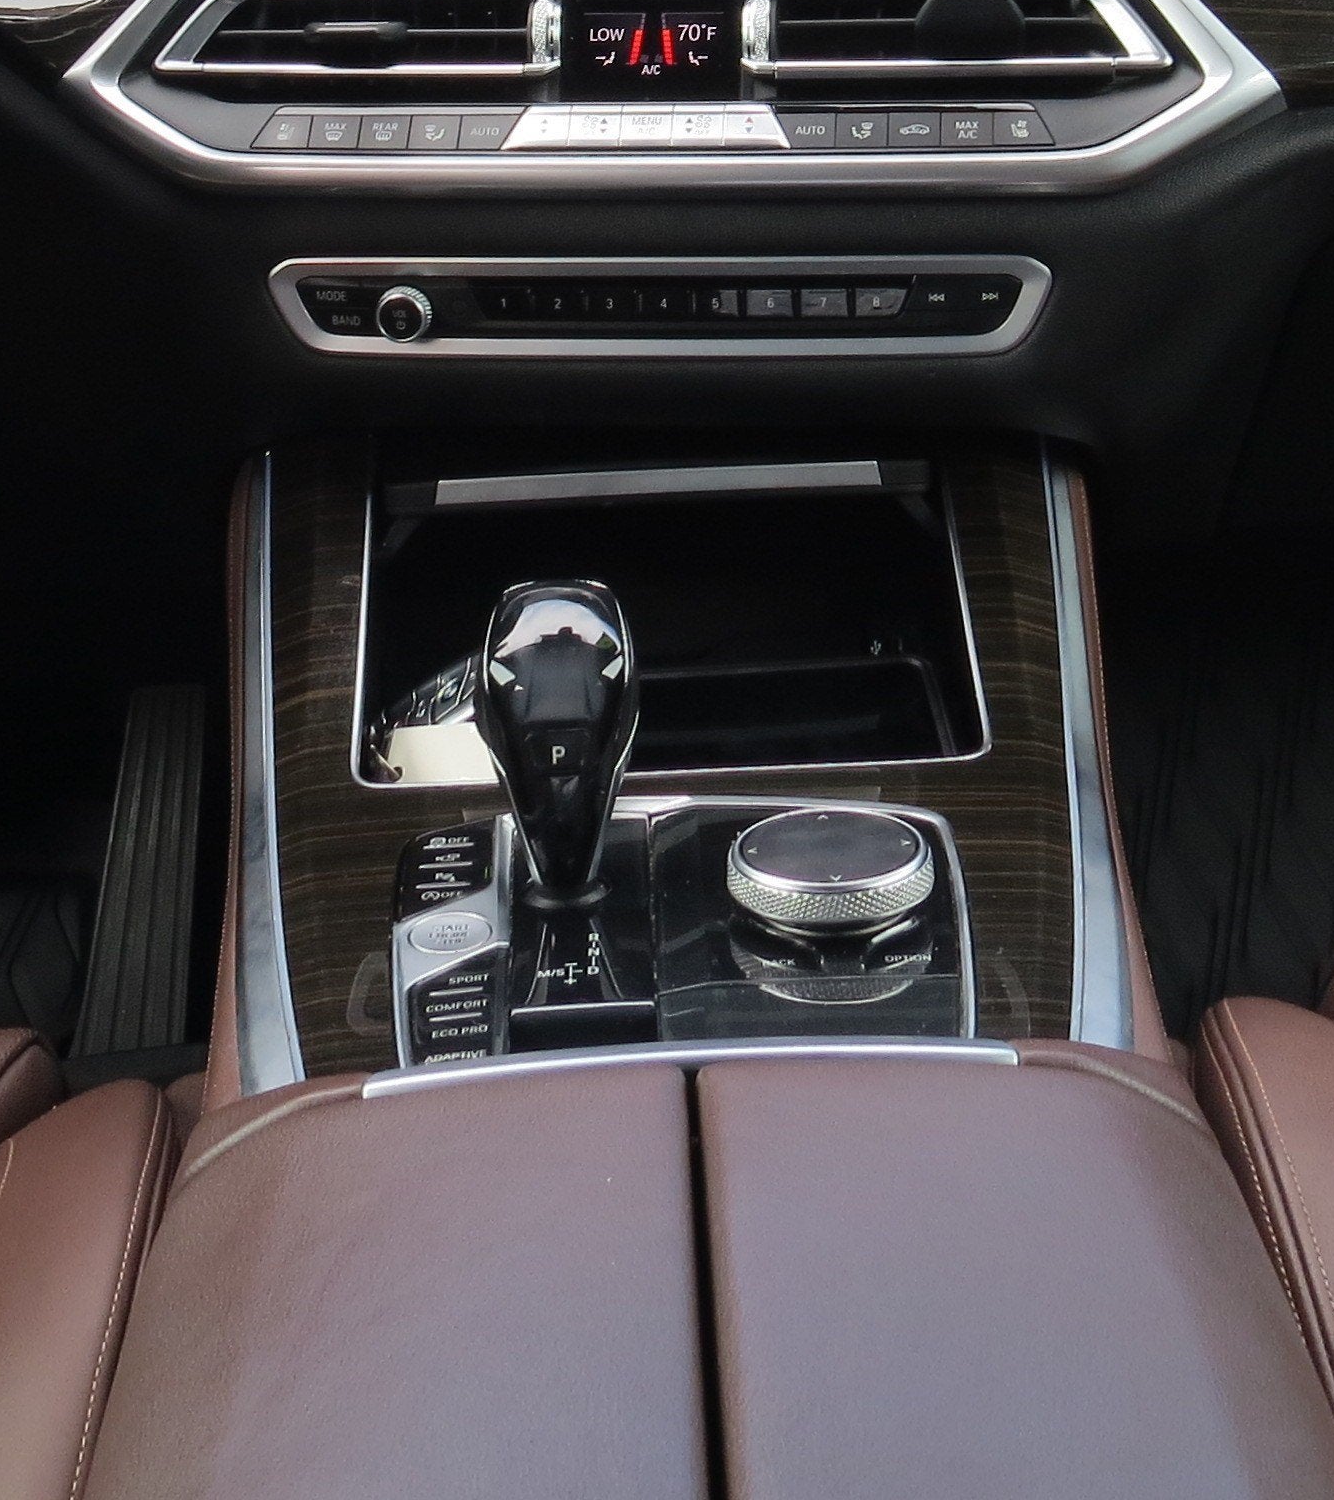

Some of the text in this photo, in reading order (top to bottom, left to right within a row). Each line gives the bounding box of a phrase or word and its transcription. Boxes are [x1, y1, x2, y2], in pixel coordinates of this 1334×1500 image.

[589, 27, 625, 43] LOW
[677, 23, 718, 42] 70°F
[640, 64, 662, 76] A/C
[631, 115, 664, 126] MENU
[955, 120, 979, 130] MAX
[325, 122, 347, 131] MAX
[372, 122, 399, 132] REAR
[795, 125, 826, 136] AUTO
[470, 127, 500, 138] AUTO
[957, 130, 978, 140] A/C
[315, 290, 347, 302] MODE
[500, 296, 881, 310] 1 2 3 4 5 6 7 8
[331, 314, 362, 327] BAND
[552, 744, 566, 764] P
[447, 836, 470, 844] OFF
[587, 947, 600, 957] N
[764, 958, 797, 968] ACK
[883, 953, 933, 963] OPTION
[536, 967, 566, 979] M/S
[586, 965, 600, 976] D
[448, 972, 490, 986] SPORT
[425, 999, 489, 1014] COMFORT
[431, 1024, 490, 1040] ECO PRO
[423, 1049, 488, 1066] ADAPTIVE
